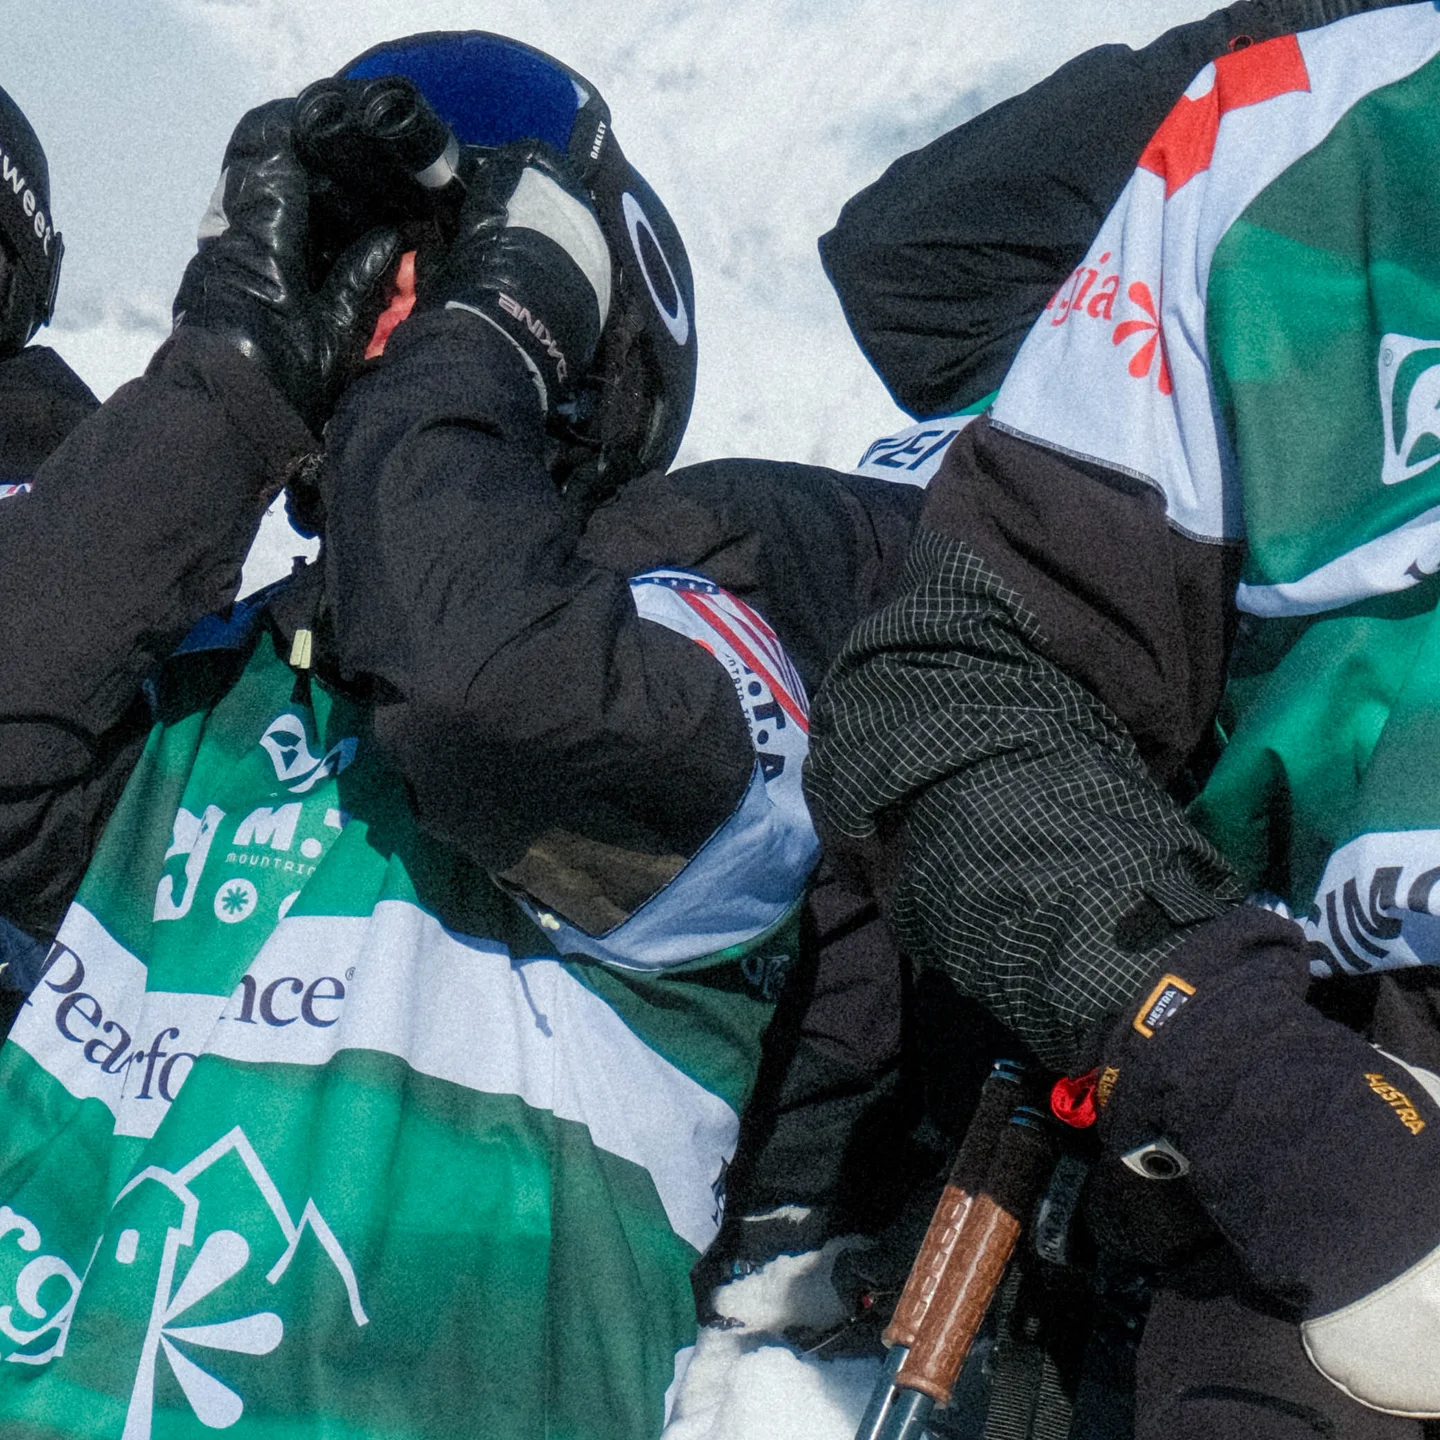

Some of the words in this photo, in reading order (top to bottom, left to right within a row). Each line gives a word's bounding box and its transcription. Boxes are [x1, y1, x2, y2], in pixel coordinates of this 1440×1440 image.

[590, 120, 606, 160] OAKLEY
[498, 291, 568, 383] DAKINE
[1146, 989, 1177, 1026] HESTRA
[1364, 1072, 1426, 1135] HESTRA
